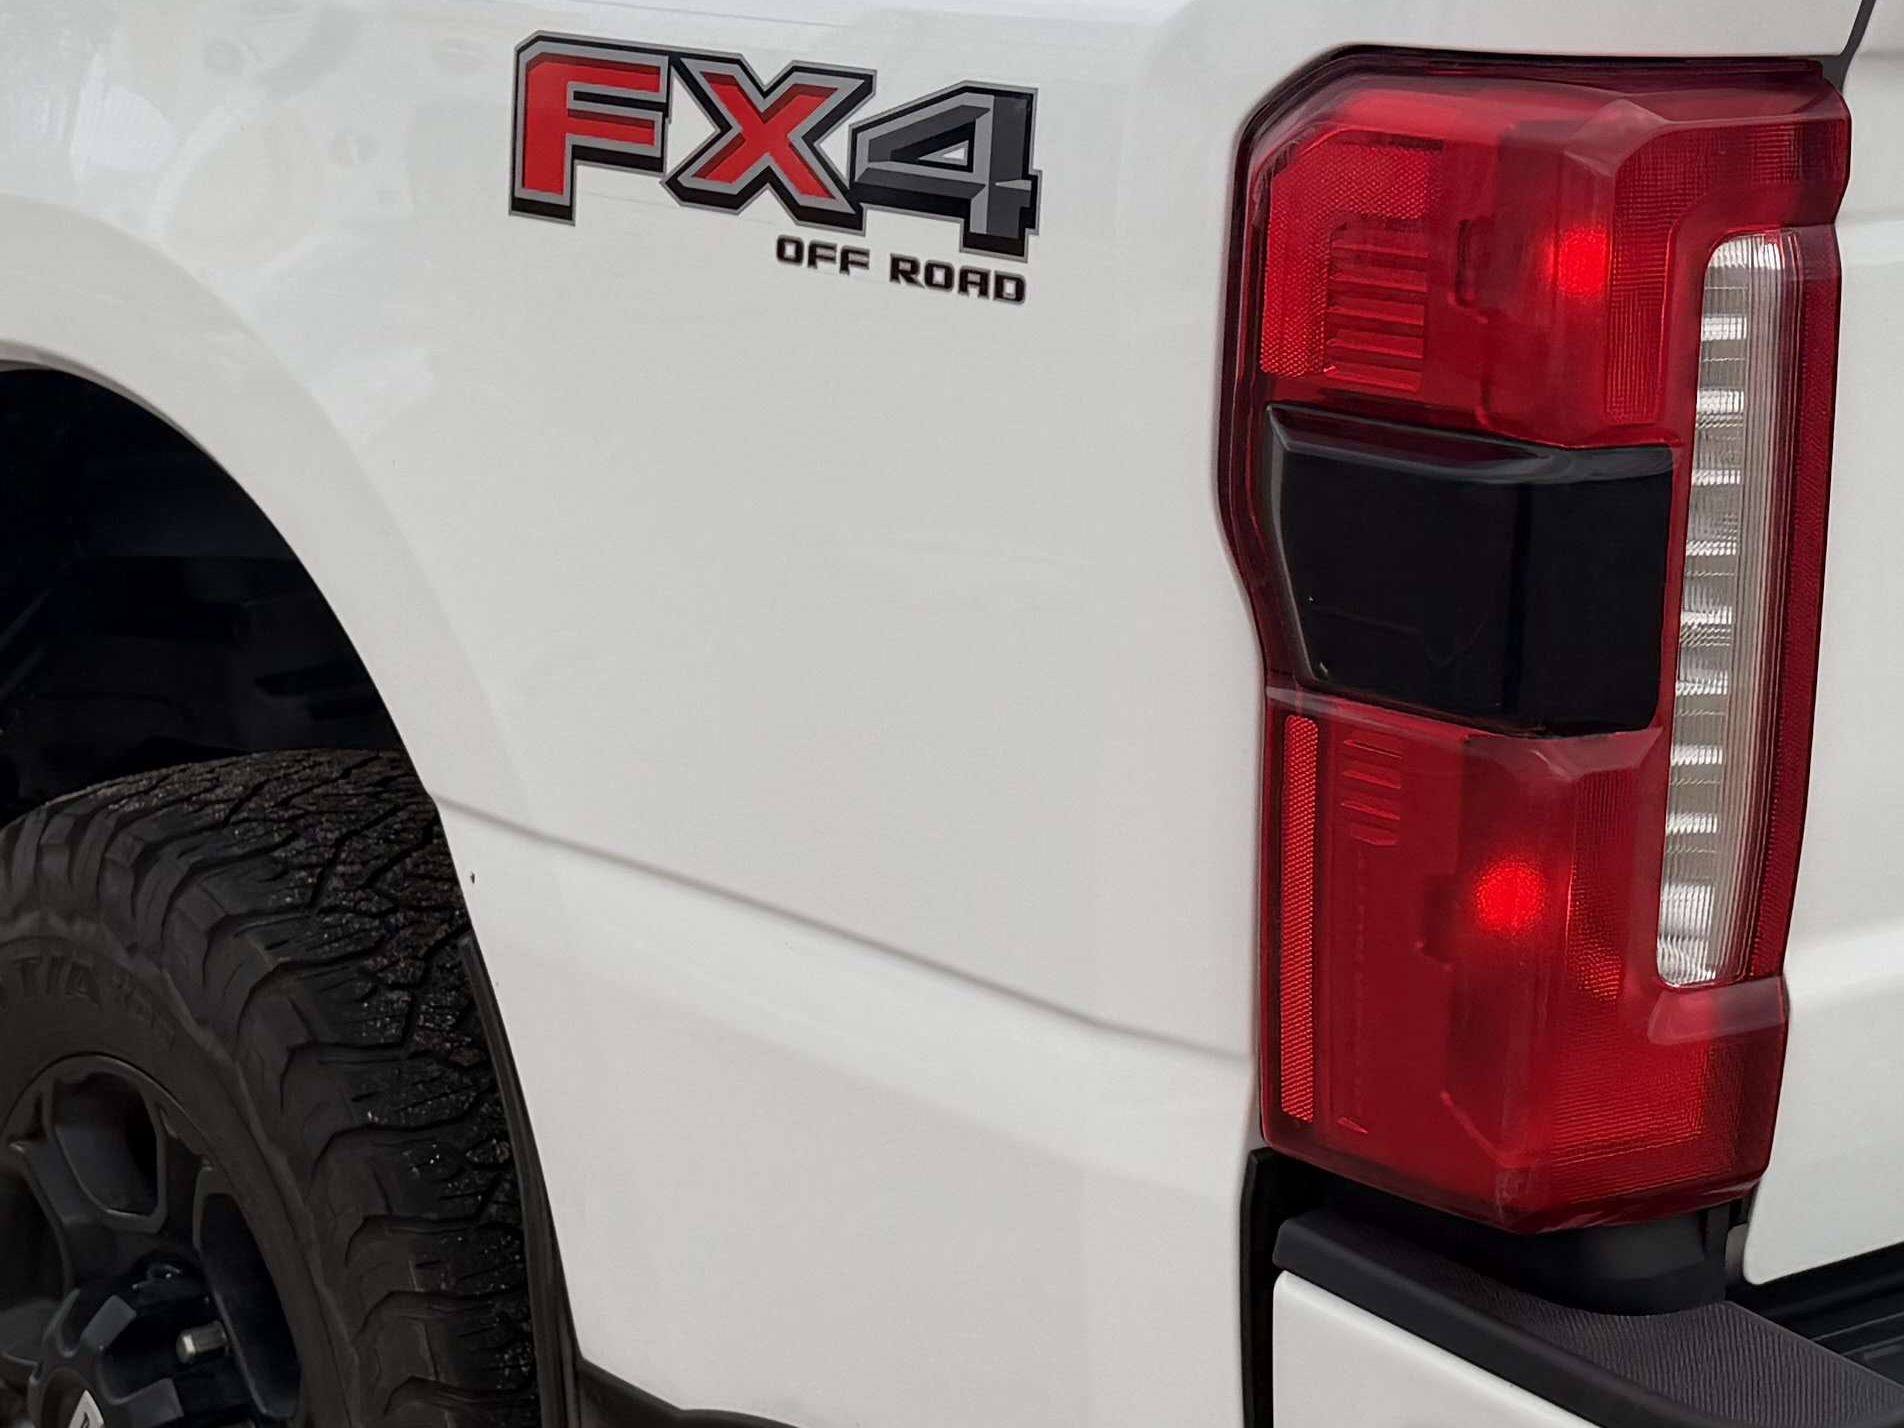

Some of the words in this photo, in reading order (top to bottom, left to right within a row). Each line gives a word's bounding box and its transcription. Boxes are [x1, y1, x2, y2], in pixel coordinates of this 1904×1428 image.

[508, 29, 1043, 262] FX4
[775, 233, 871, 276] OFF
[888, 252, 1027, 305] ROAD
